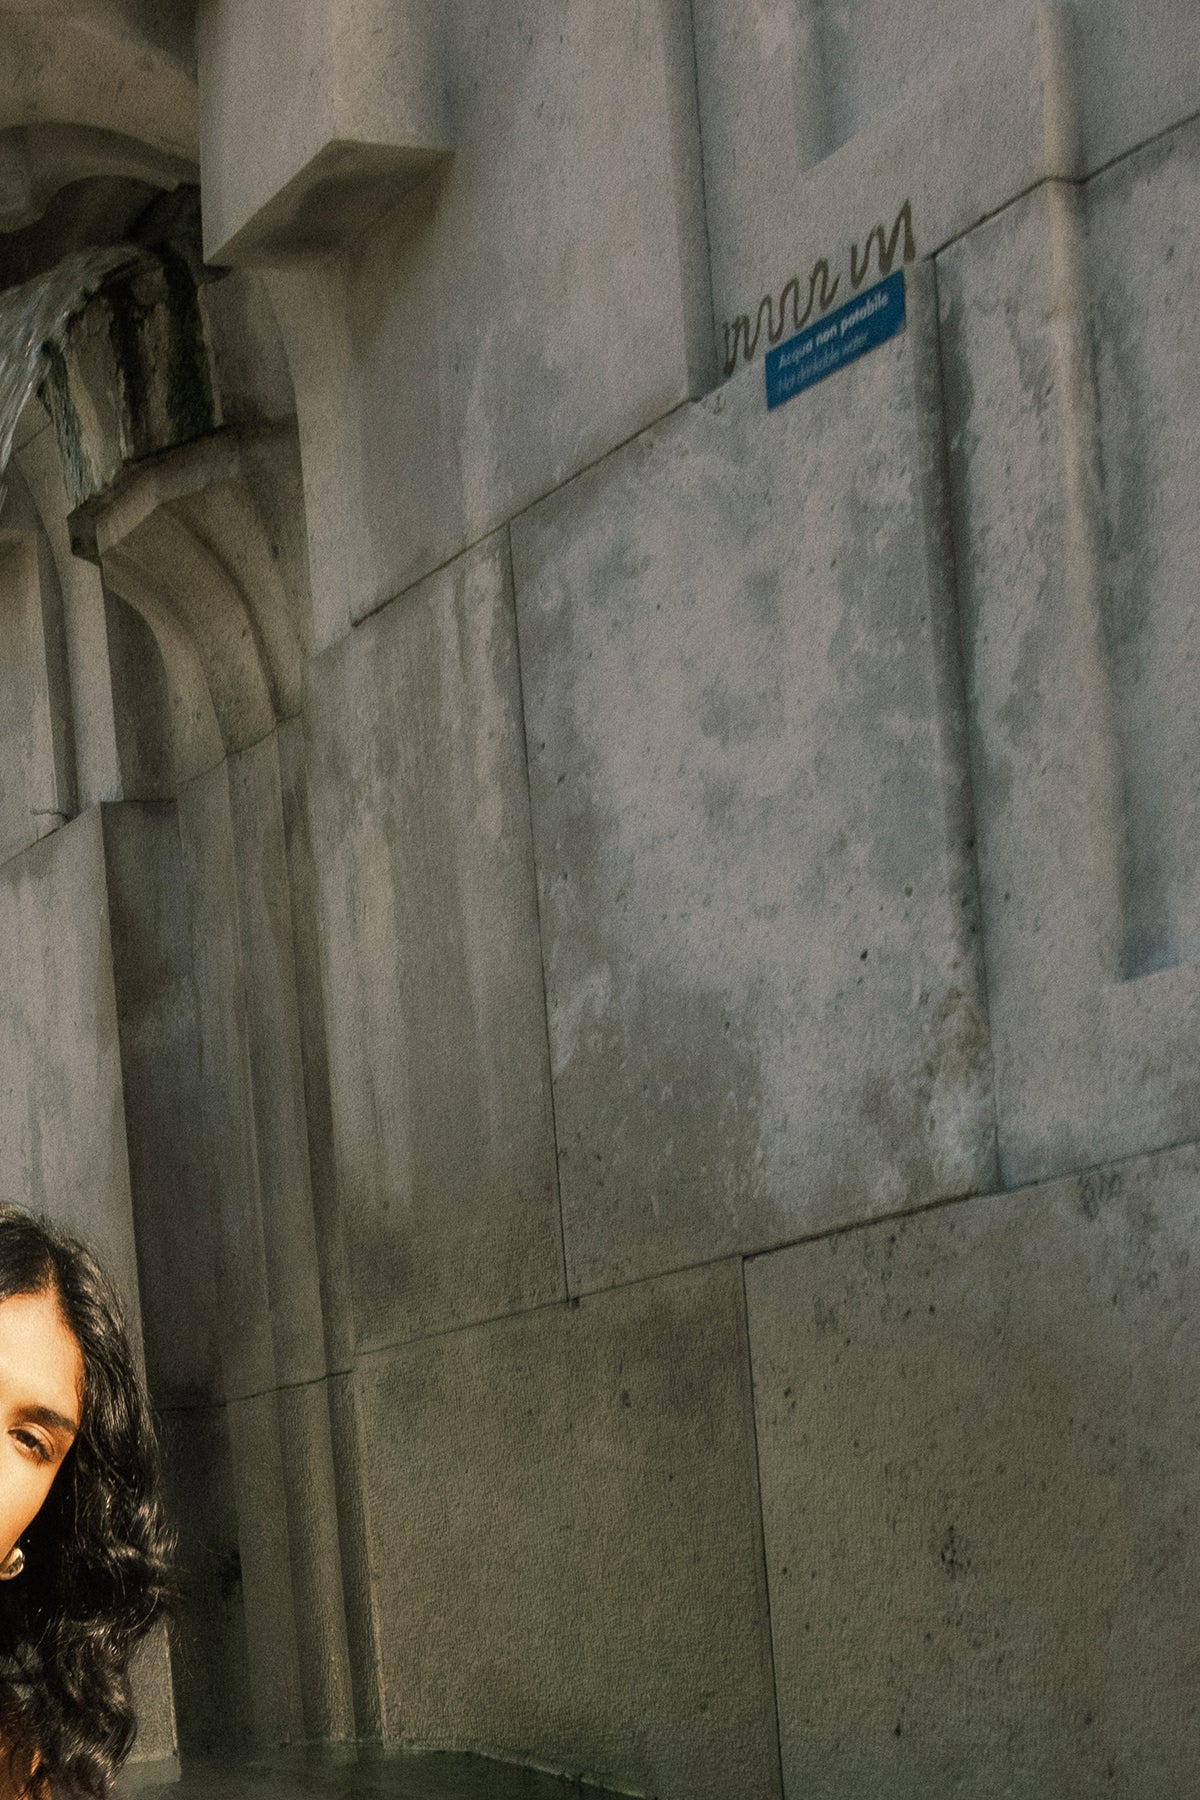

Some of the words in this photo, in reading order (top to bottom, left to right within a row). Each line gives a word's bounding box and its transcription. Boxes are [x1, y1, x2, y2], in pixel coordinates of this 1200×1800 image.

[778, 340, 813, 370] Acqua
[816, 324, 837, 346] non
[840, 292, 889, 334] potabile
